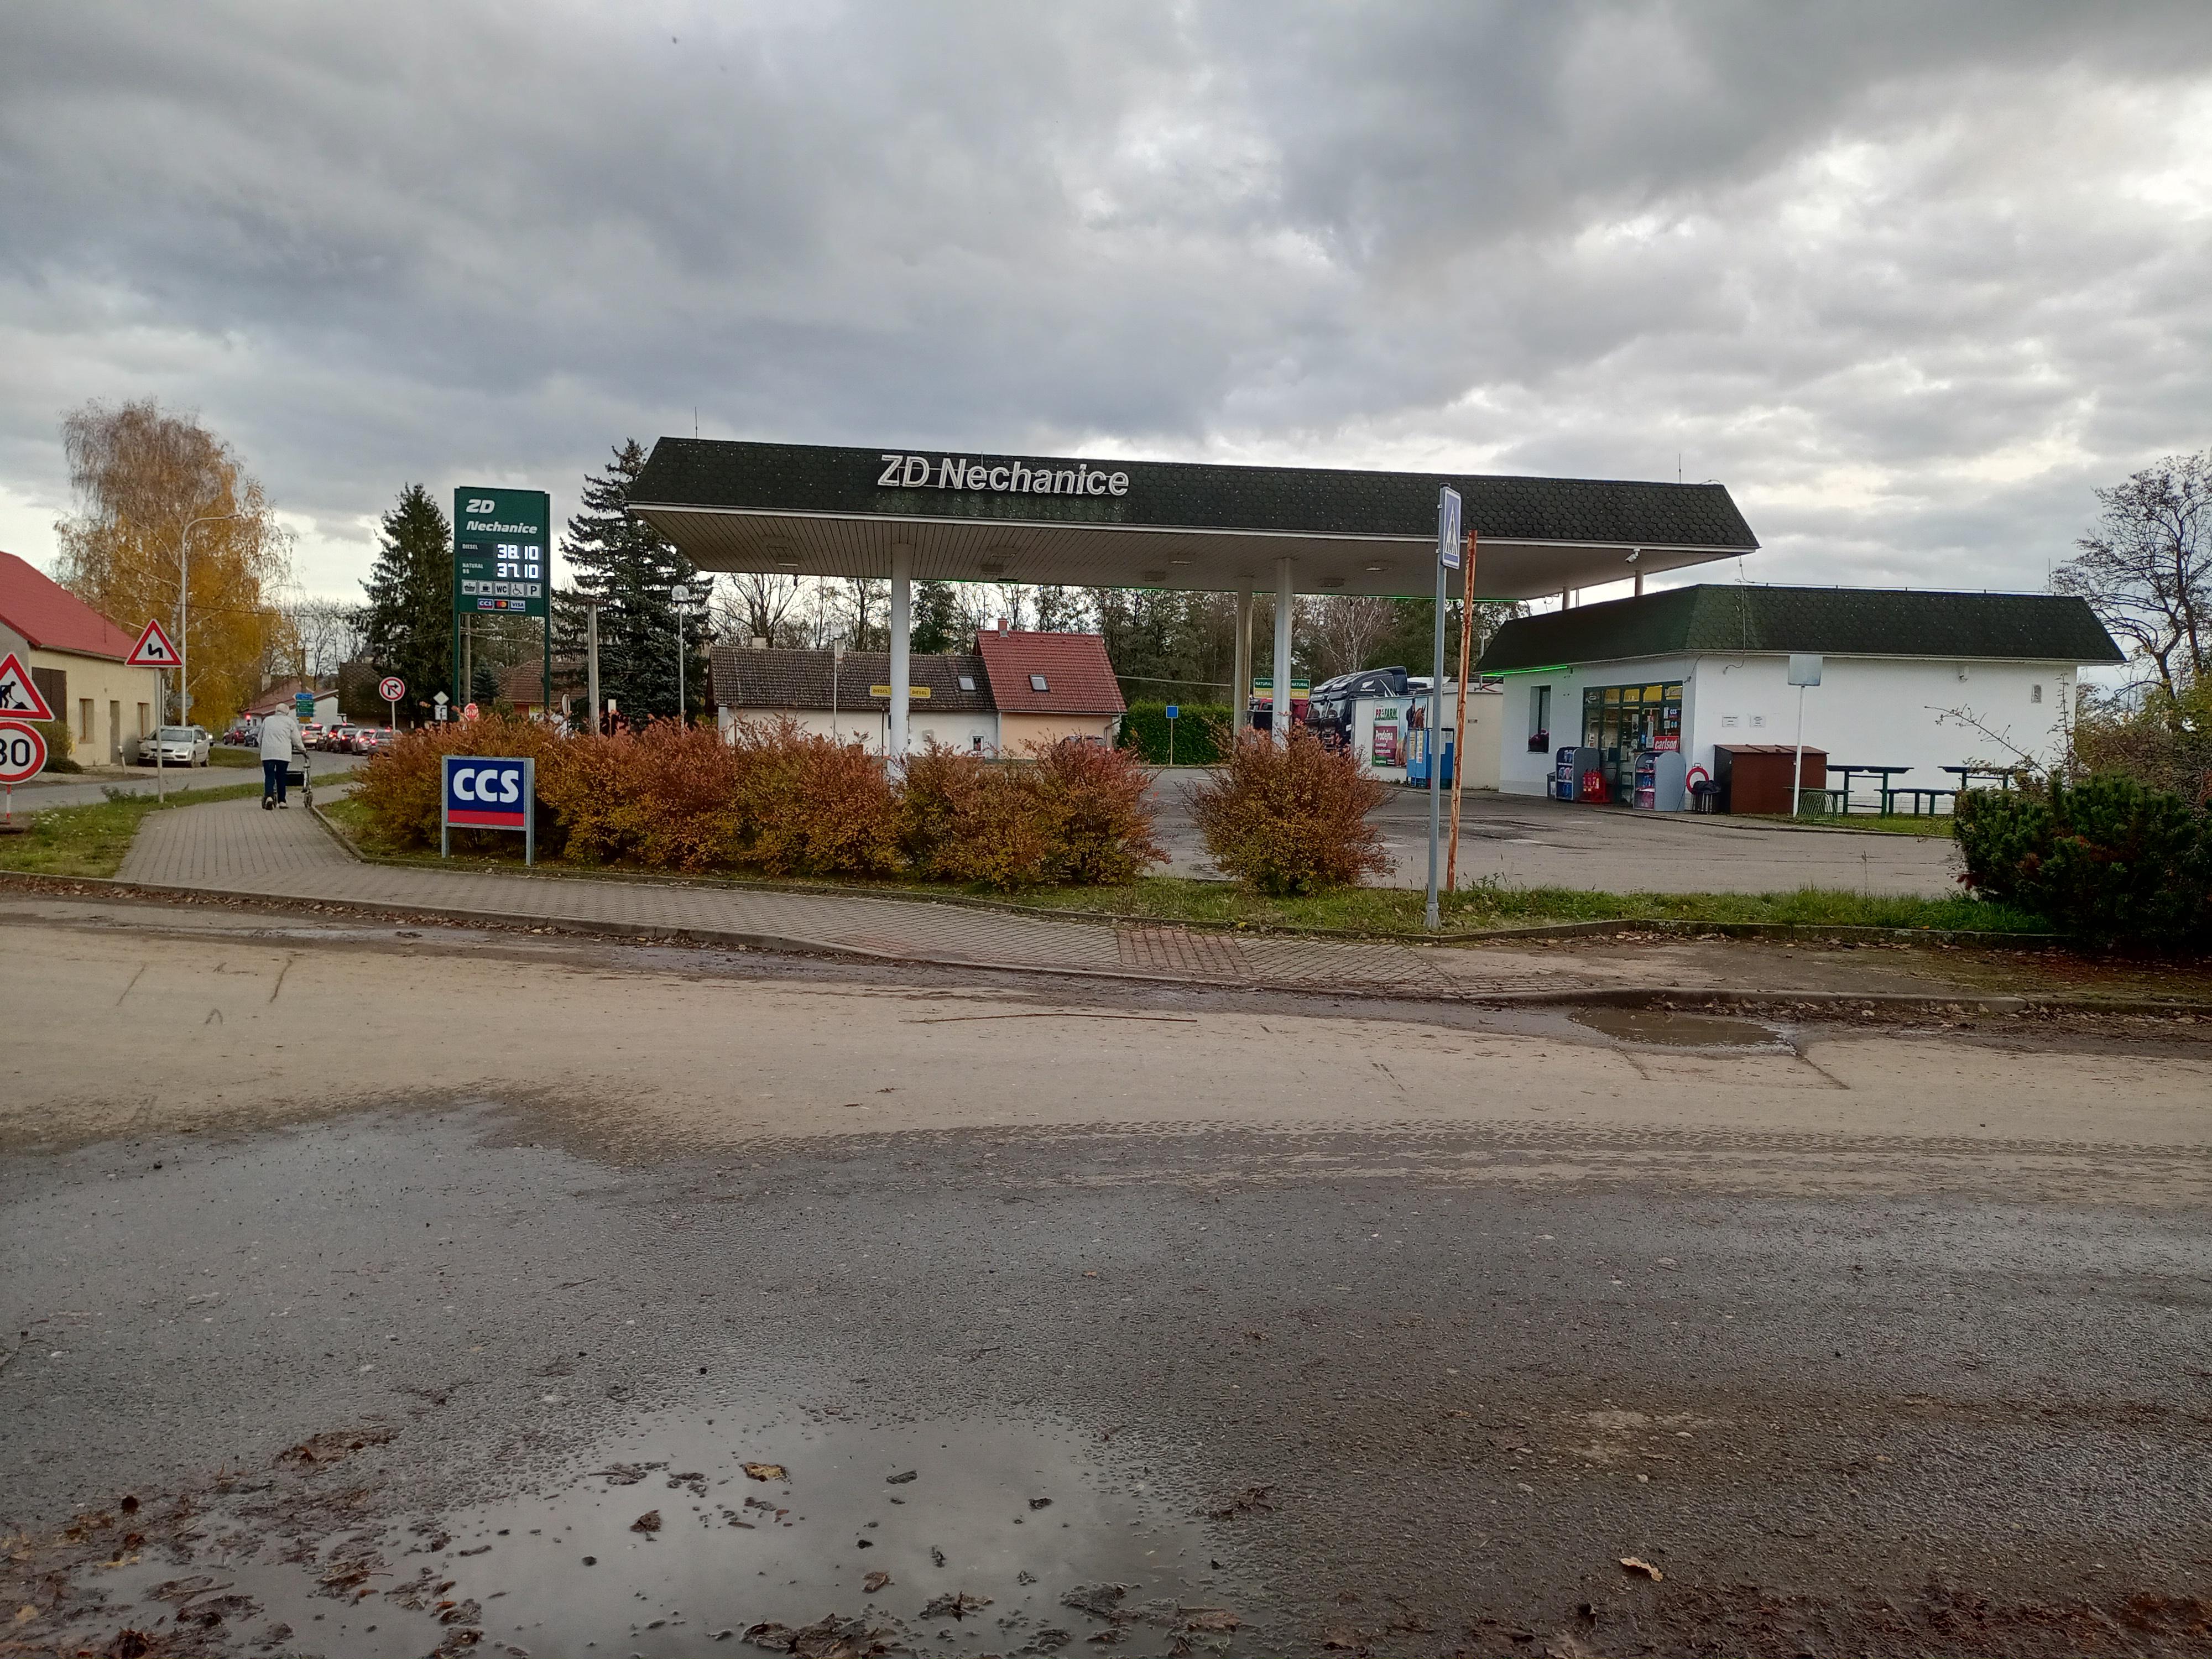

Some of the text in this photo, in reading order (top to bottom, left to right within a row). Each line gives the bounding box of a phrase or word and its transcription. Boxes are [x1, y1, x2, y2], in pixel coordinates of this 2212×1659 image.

[877, 454, 1129, 496] ZD Nechanice
[466, 499, 495, 514] ZD
[466, 520, 538, 534] Nechanice
[530, 586, 537, 595] P
[1375, 729, 1393, 743] Prodejna
[1655, 738, 1677, 750] carlson
[453, 768, 519, 804] CCS
